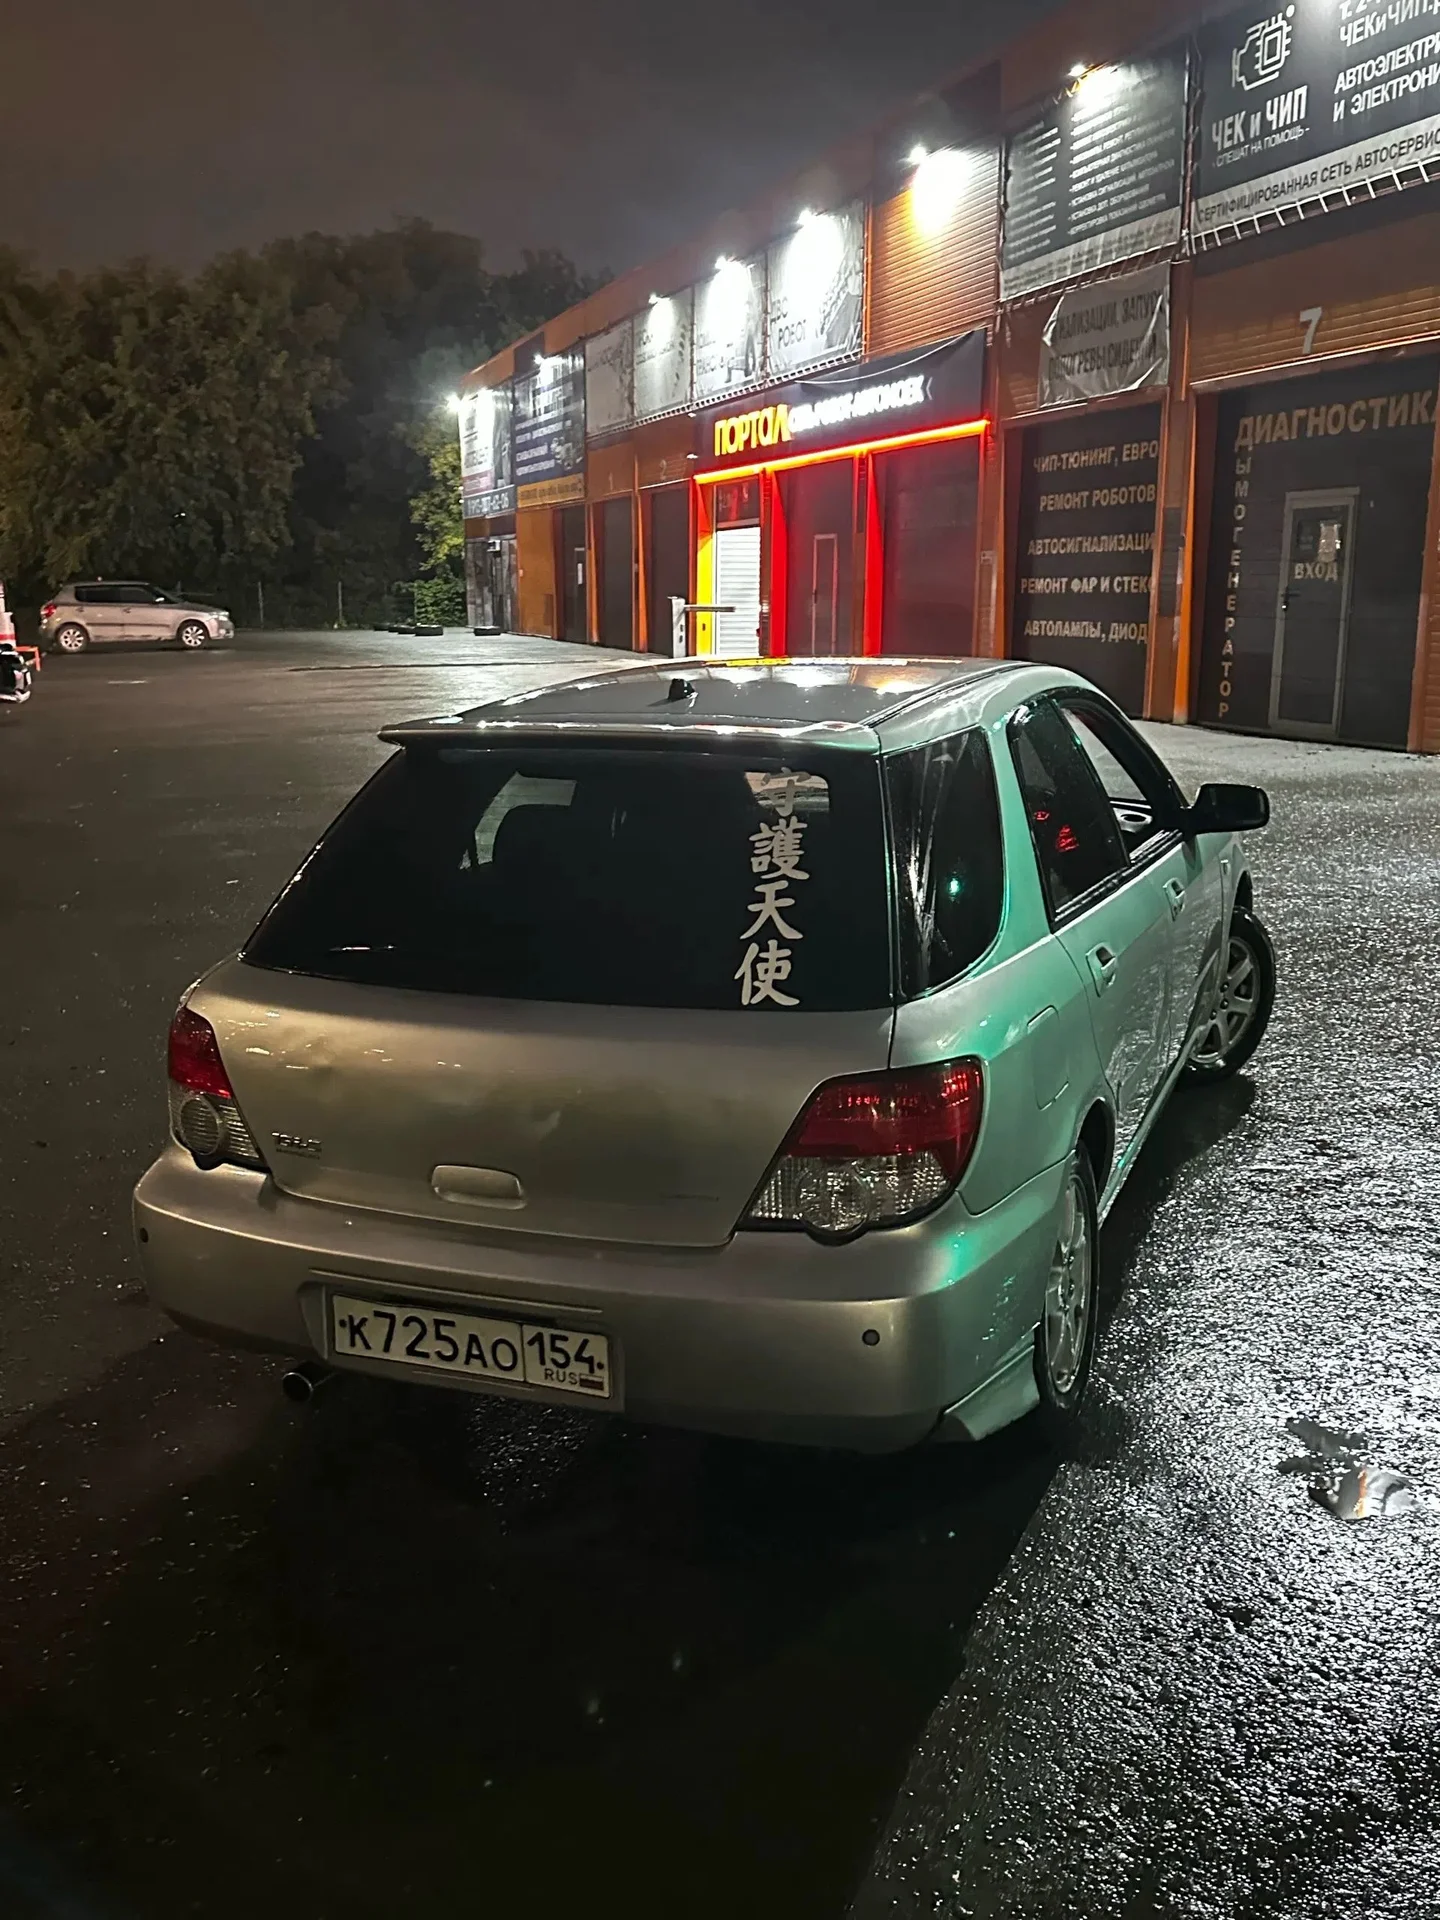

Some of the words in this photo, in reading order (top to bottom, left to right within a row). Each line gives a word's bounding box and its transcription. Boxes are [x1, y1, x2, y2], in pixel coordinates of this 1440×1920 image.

[1212, 110, 1246, 151] ЧЕК
[1266, 85, 1308, 131] ЧИП
[1333, 100, 1345, 122] И
[1251, 141, 1262, 155] НА
[1320, 160, 1352, 183] СЕТЬ
[1299, 306, 1321, 354] 7
[714, 403, 793, 457] ПОРТАЛ
[1122, 440, 1158, 462] ЕВРО
[1040, 491, 1088, 512] РЕМОНТ
[1092, 484, 1156, 507] РОБОТОВ
[1294, 562, 1338, 582] ВХОД
[1021, 577, 1068, 593] РЕМОНТ
[1071, 576, 1098, 593] ФАР
[1100, 577, 1109, 593] И
[348, 1310, 518, 1372] К725АО
[527, 1332, 594, 1374] 154
[544, 1367, 578, 1385] RUS
